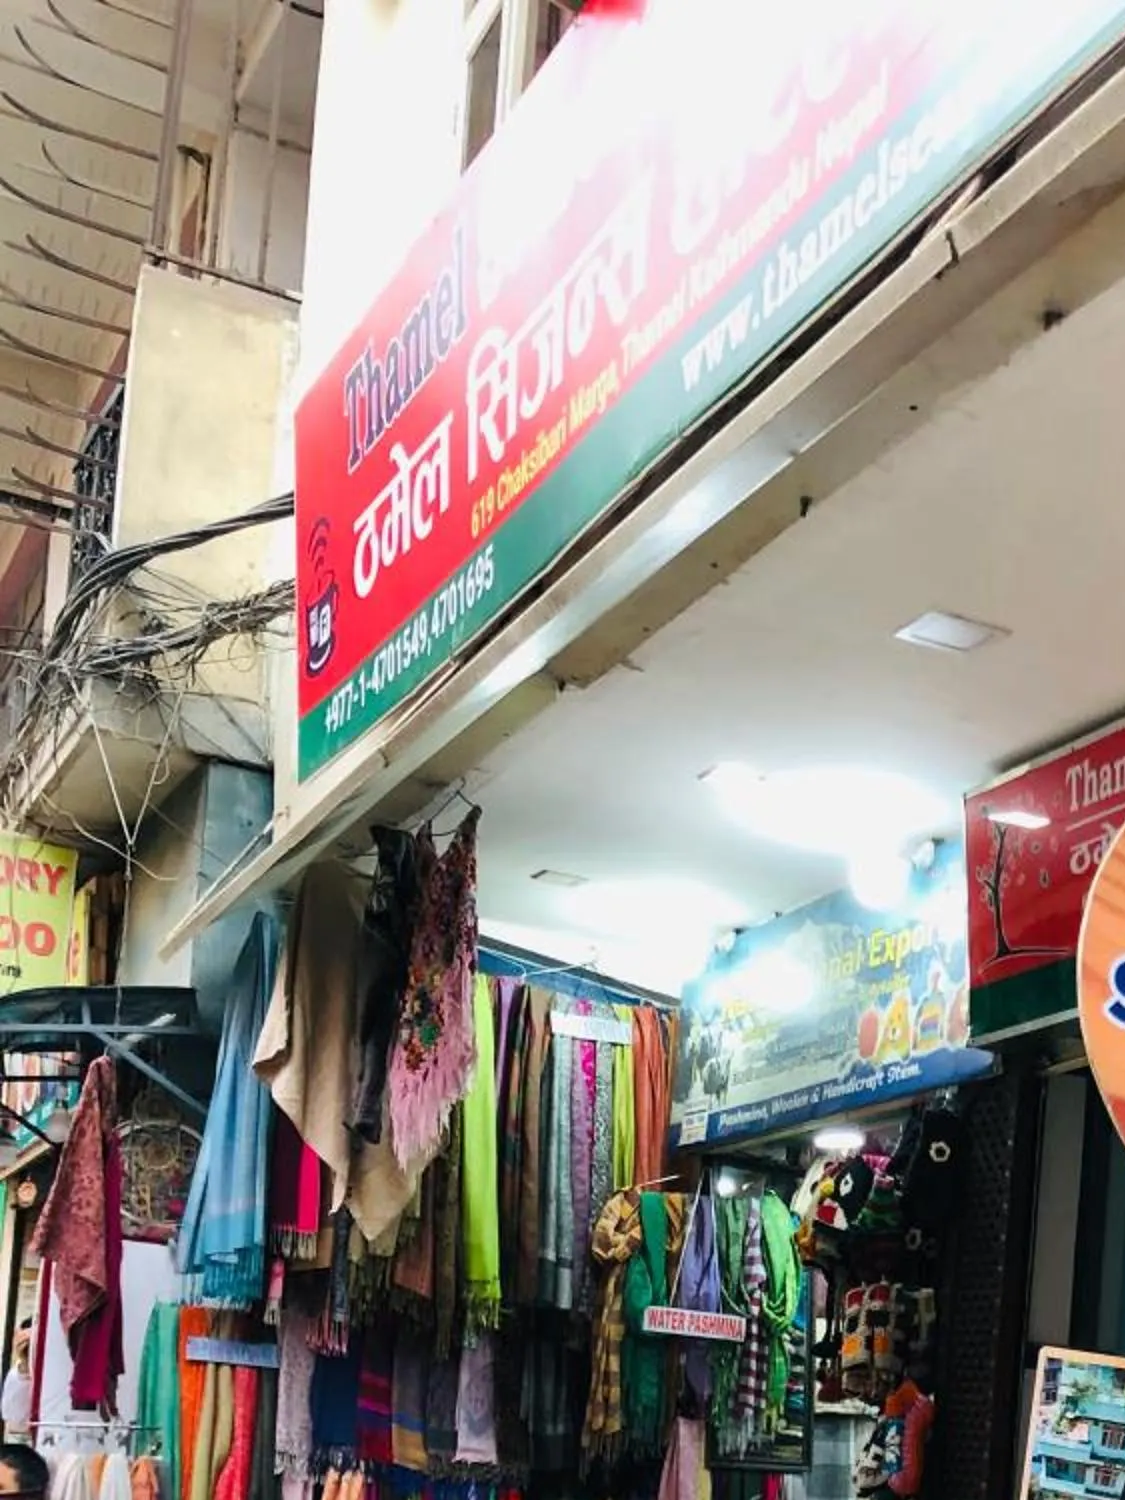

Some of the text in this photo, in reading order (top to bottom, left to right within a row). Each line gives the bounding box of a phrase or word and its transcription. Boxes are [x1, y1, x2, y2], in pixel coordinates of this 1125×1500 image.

[344, 224, 466, 474] Thamel
[353, 410, 454, 598] ठमेल
[471, 499, 495, 539] 619
[648, 1309, 743, 1338] WATER PASHMINA
